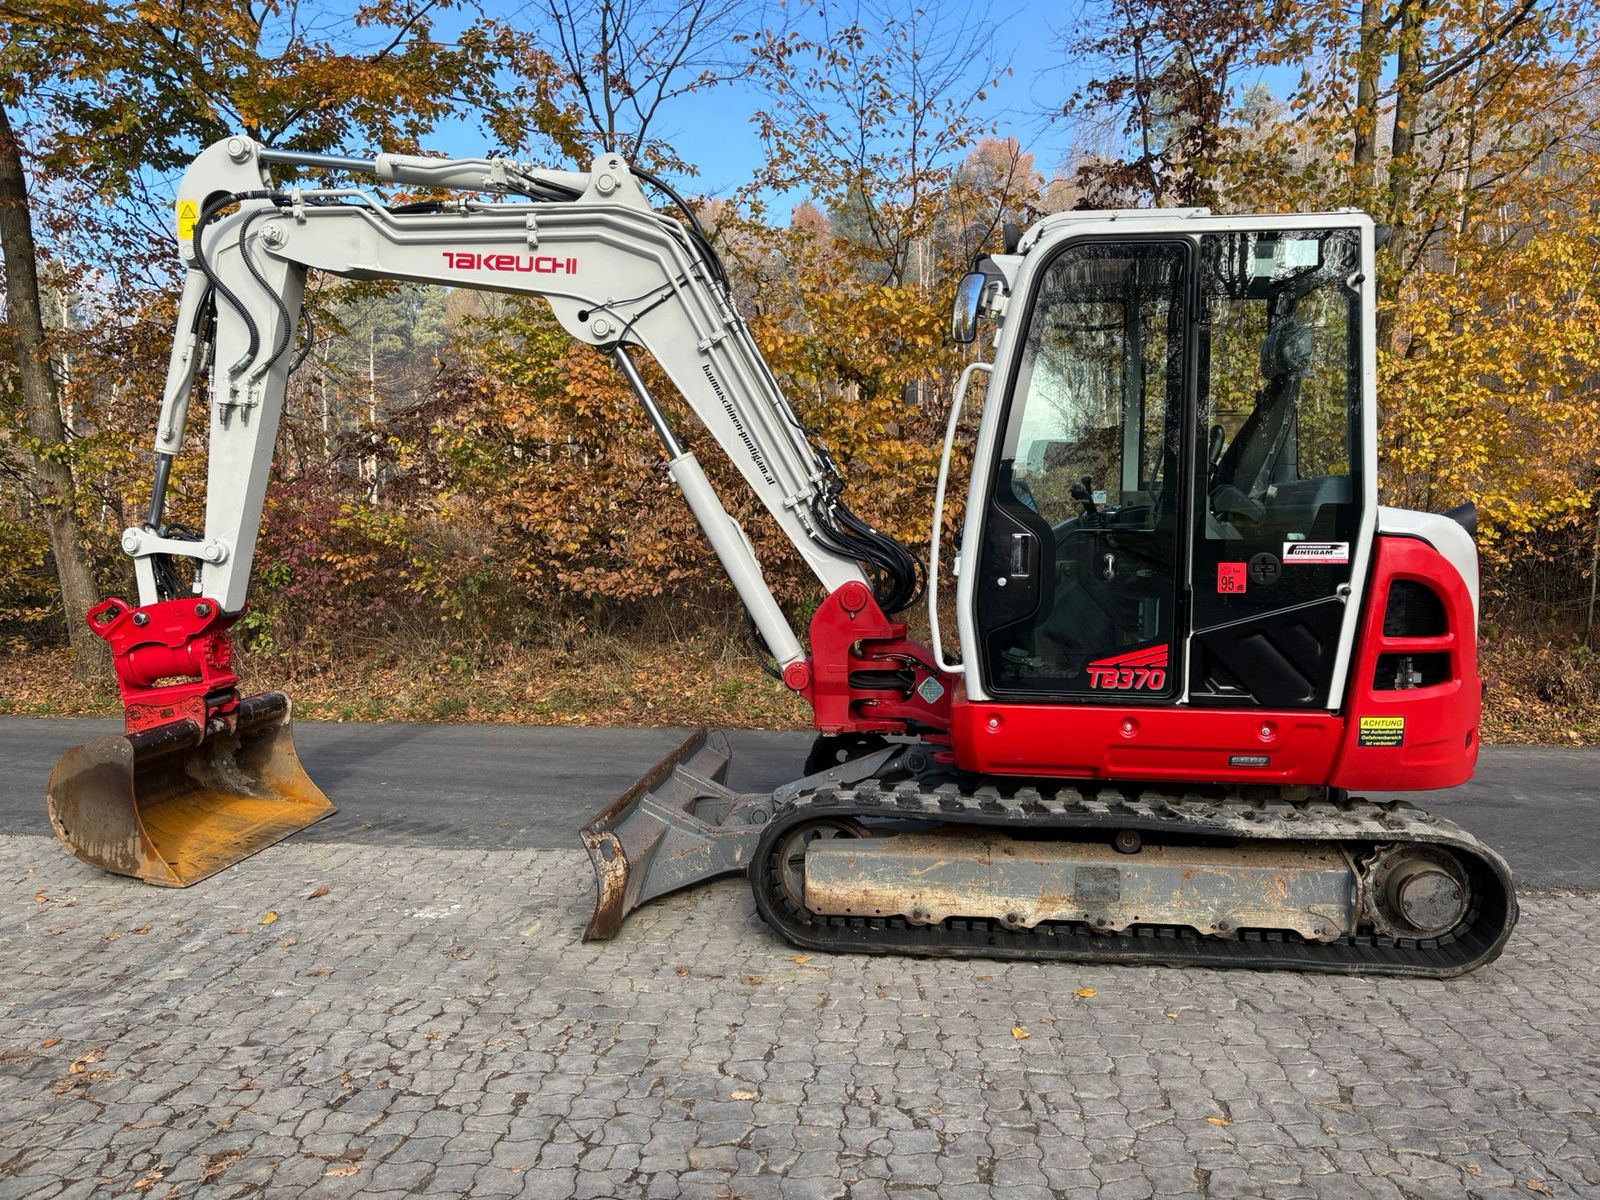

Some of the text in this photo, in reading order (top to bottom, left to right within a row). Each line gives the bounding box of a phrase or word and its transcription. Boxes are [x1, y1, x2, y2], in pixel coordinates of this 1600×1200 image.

[702, 364, 776, 486] baumaschinen-puntigam.at
[1220, 576, 1235, 591] 95
[1086, 667, 1166, 690] TB370
[1362, 719, 1403, 727] ACHTUNG
